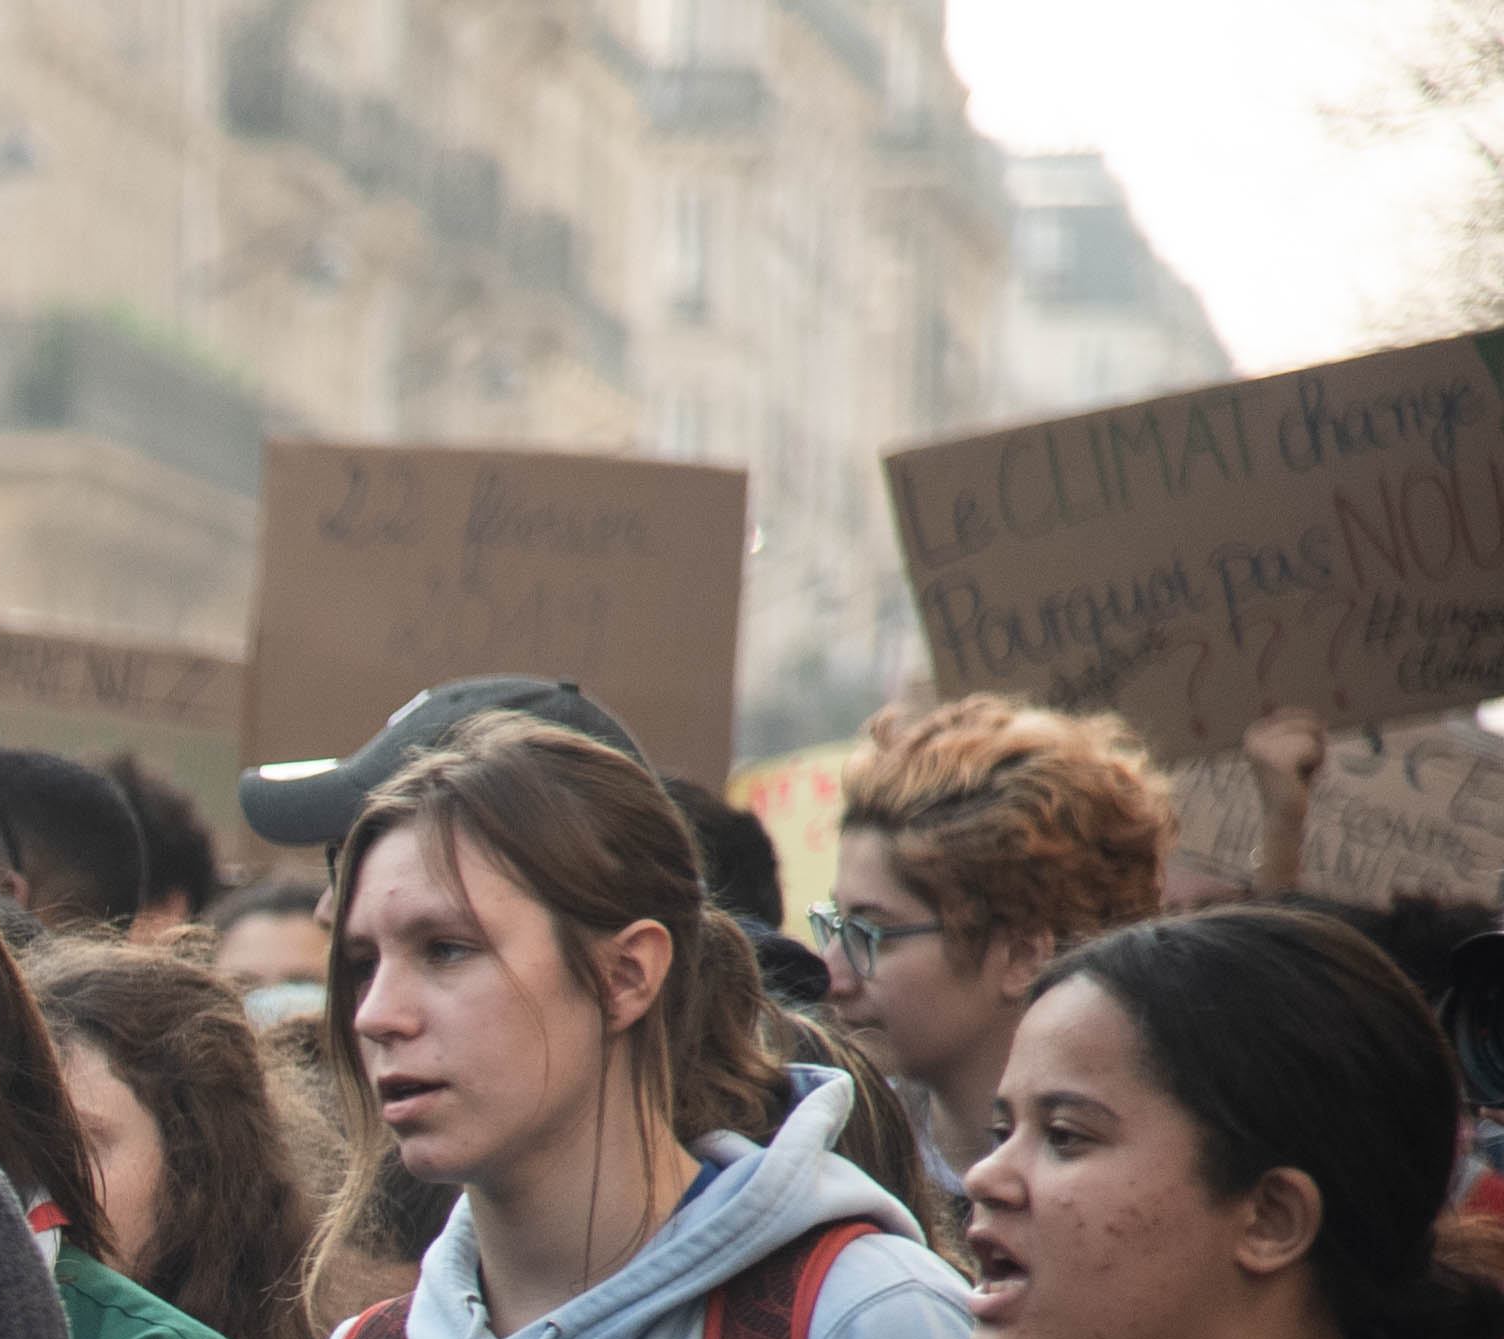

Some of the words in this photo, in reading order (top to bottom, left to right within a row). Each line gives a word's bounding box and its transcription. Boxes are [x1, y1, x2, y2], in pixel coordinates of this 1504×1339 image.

[898, 464, 996, 568] Le
[998, 393, 1263, 540] CLIMAT
[1277, 372, 1484, 474] change
[918, 556, 1208, 682] Pourquoi
[1210, 524, 1338, 650] pas
